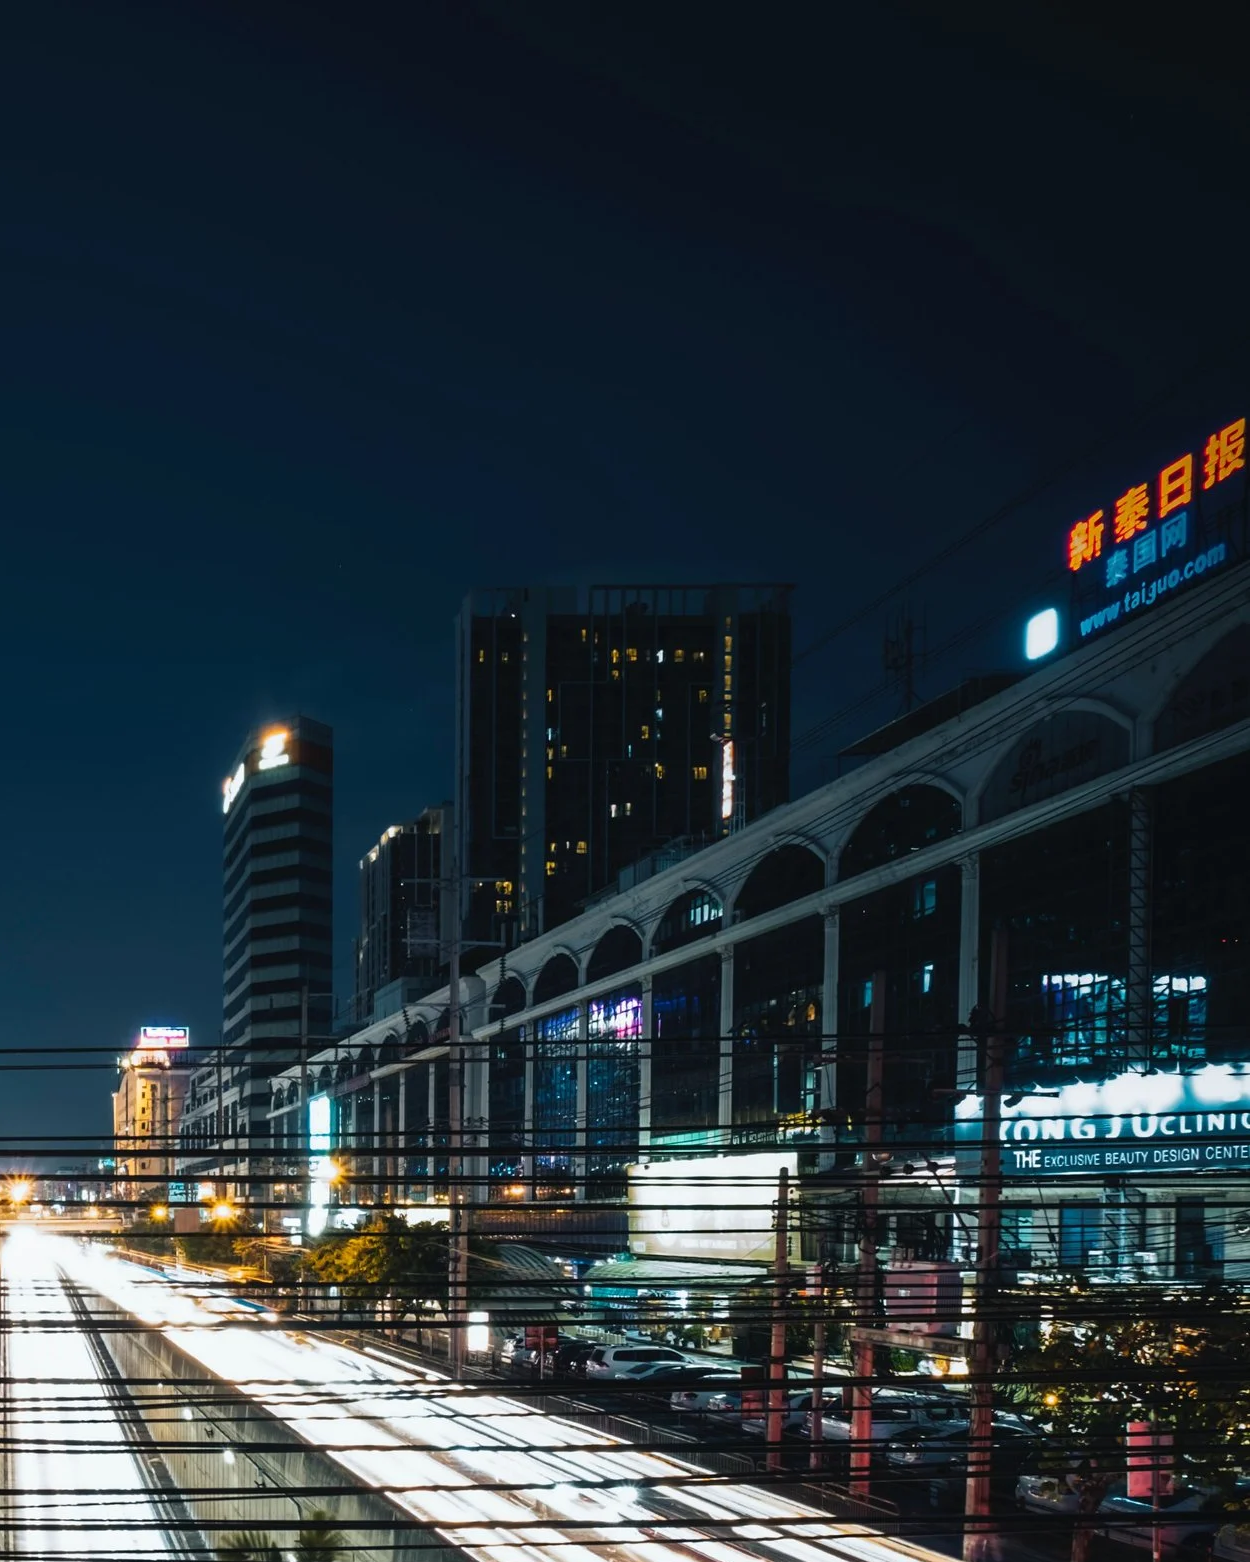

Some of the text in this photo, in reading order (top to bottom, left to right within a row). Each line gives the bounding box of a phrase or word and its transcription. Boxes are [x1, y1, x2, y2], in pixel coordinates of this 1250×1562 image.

[1067, 416, 1247, 573] 新泰日报
[1105, 511, 1188, 589] 泰国网
[1080, 542, 1226, 637] www.taiguo.com
[1013, 1144, 1250, 1169] THE EXCLUSIVE BEAUTY DESIGN CENTE
[1160, 1112, 1250, 1135] CLINIC
